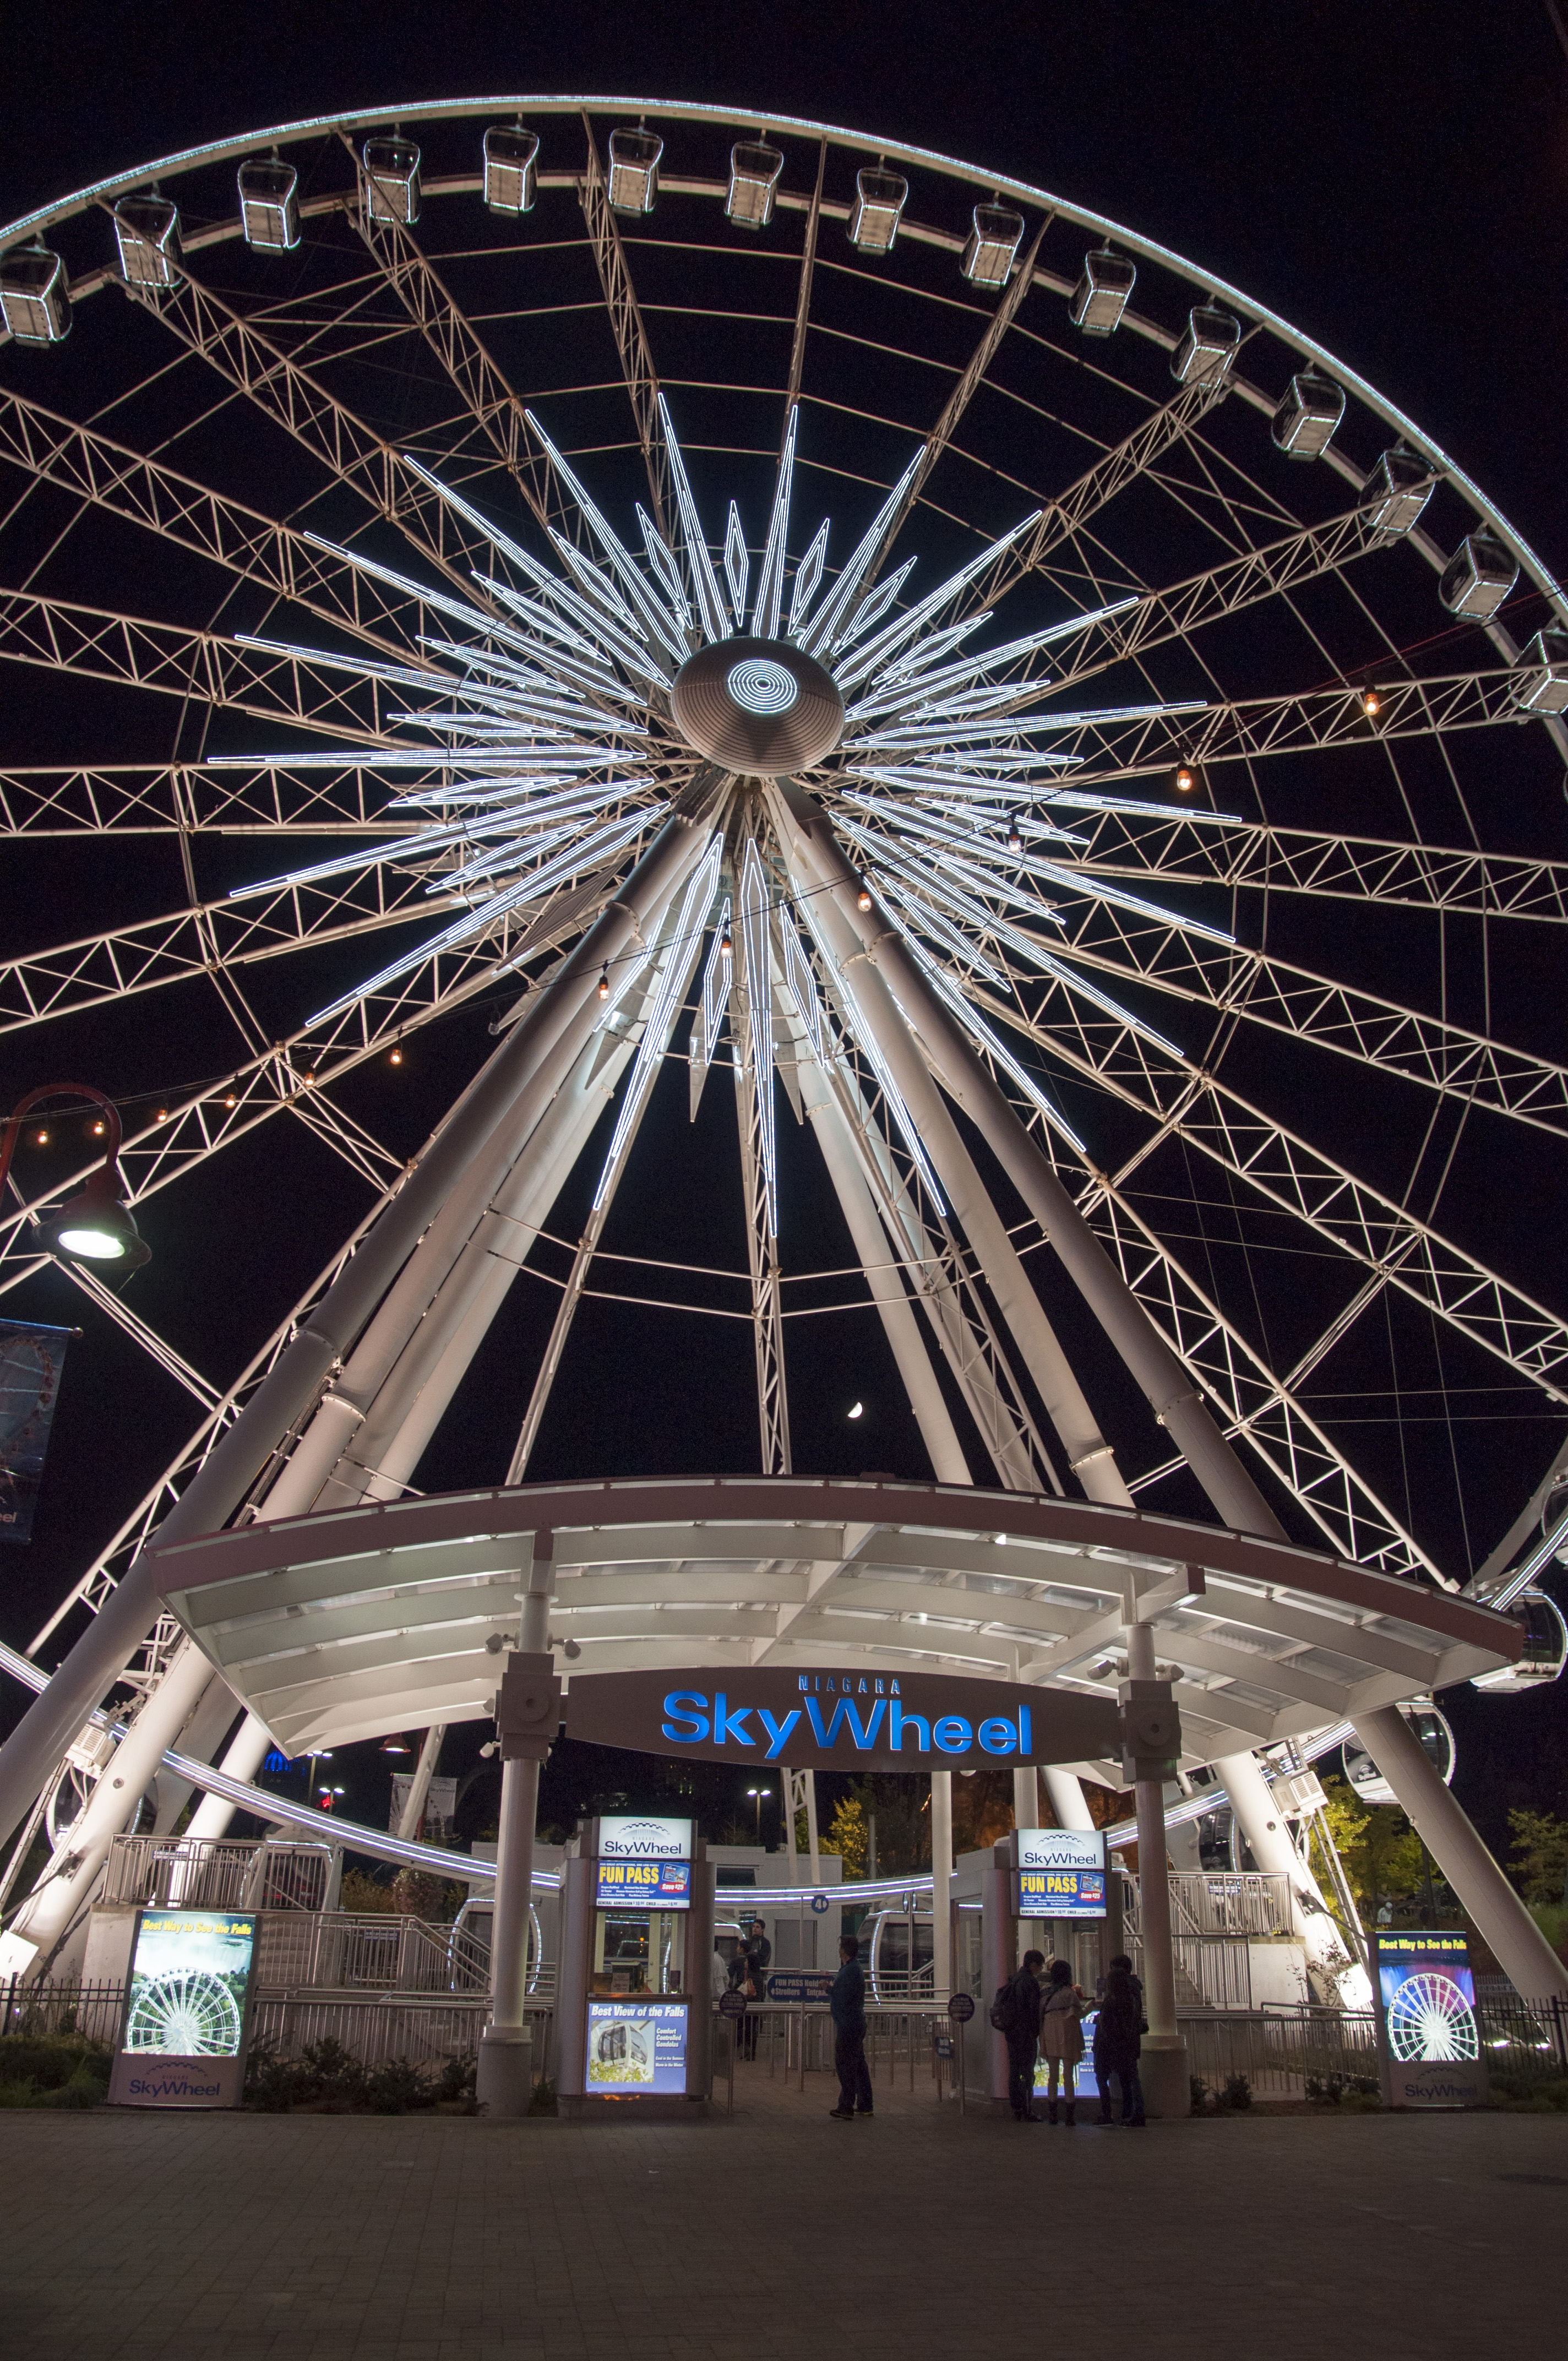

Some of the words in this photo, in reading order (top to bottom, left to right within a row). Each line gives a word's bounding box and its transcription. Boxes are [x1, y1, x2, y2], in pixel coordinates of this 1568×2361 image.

[798, 1674, 901, 1695] NIAGARA
[662, 1689, 1032, 1759] SkyWheel
[605, 1841, 682, 1855] SkyWheel
[1024, 1852, 1096, 1866] SkyWheel
[599, 1867, 624, 1883] FUN
[626, 1867, 660, 1884] PASS
[1021, 1876, 1045, 1892] FUN
[1047, 1876, 1077, 1893] PASS
[815, 1898, 822, 1909] 4
[143, 1919, 162, 1930] Best
[164, 1920, 182, 1934] Way
[184, 1922, 194, 1932] to
[195, 1922, 213, 1933] See
[215, 1923, 229, 1934] the
[231, 1923, 252, 1935] Falls
[1379, 1939, 1398, 1949] Best
[1398, 1939, 1416, 1951] Way
[1417, 1940, 1425, 1949] to
[1427, 1939, 1440, 1949] See
[1441, 1939, 1452, 1949] the
[1452, 1939, 1467, 1950] Falls
[775, 1988, 801, 1996] Strollers
[591, 2005, 612, 2016] Best
[614, 2006, 635, 2017] View
[637, 2006, 647, 2017] of
[649, 2006, 663, 2017] the
[665, 2006, 684, 2017] Falls
[129, 2079, 220, 2097] SkyWheel
[1404, 2083, 1477, 2100] SkyWheel
